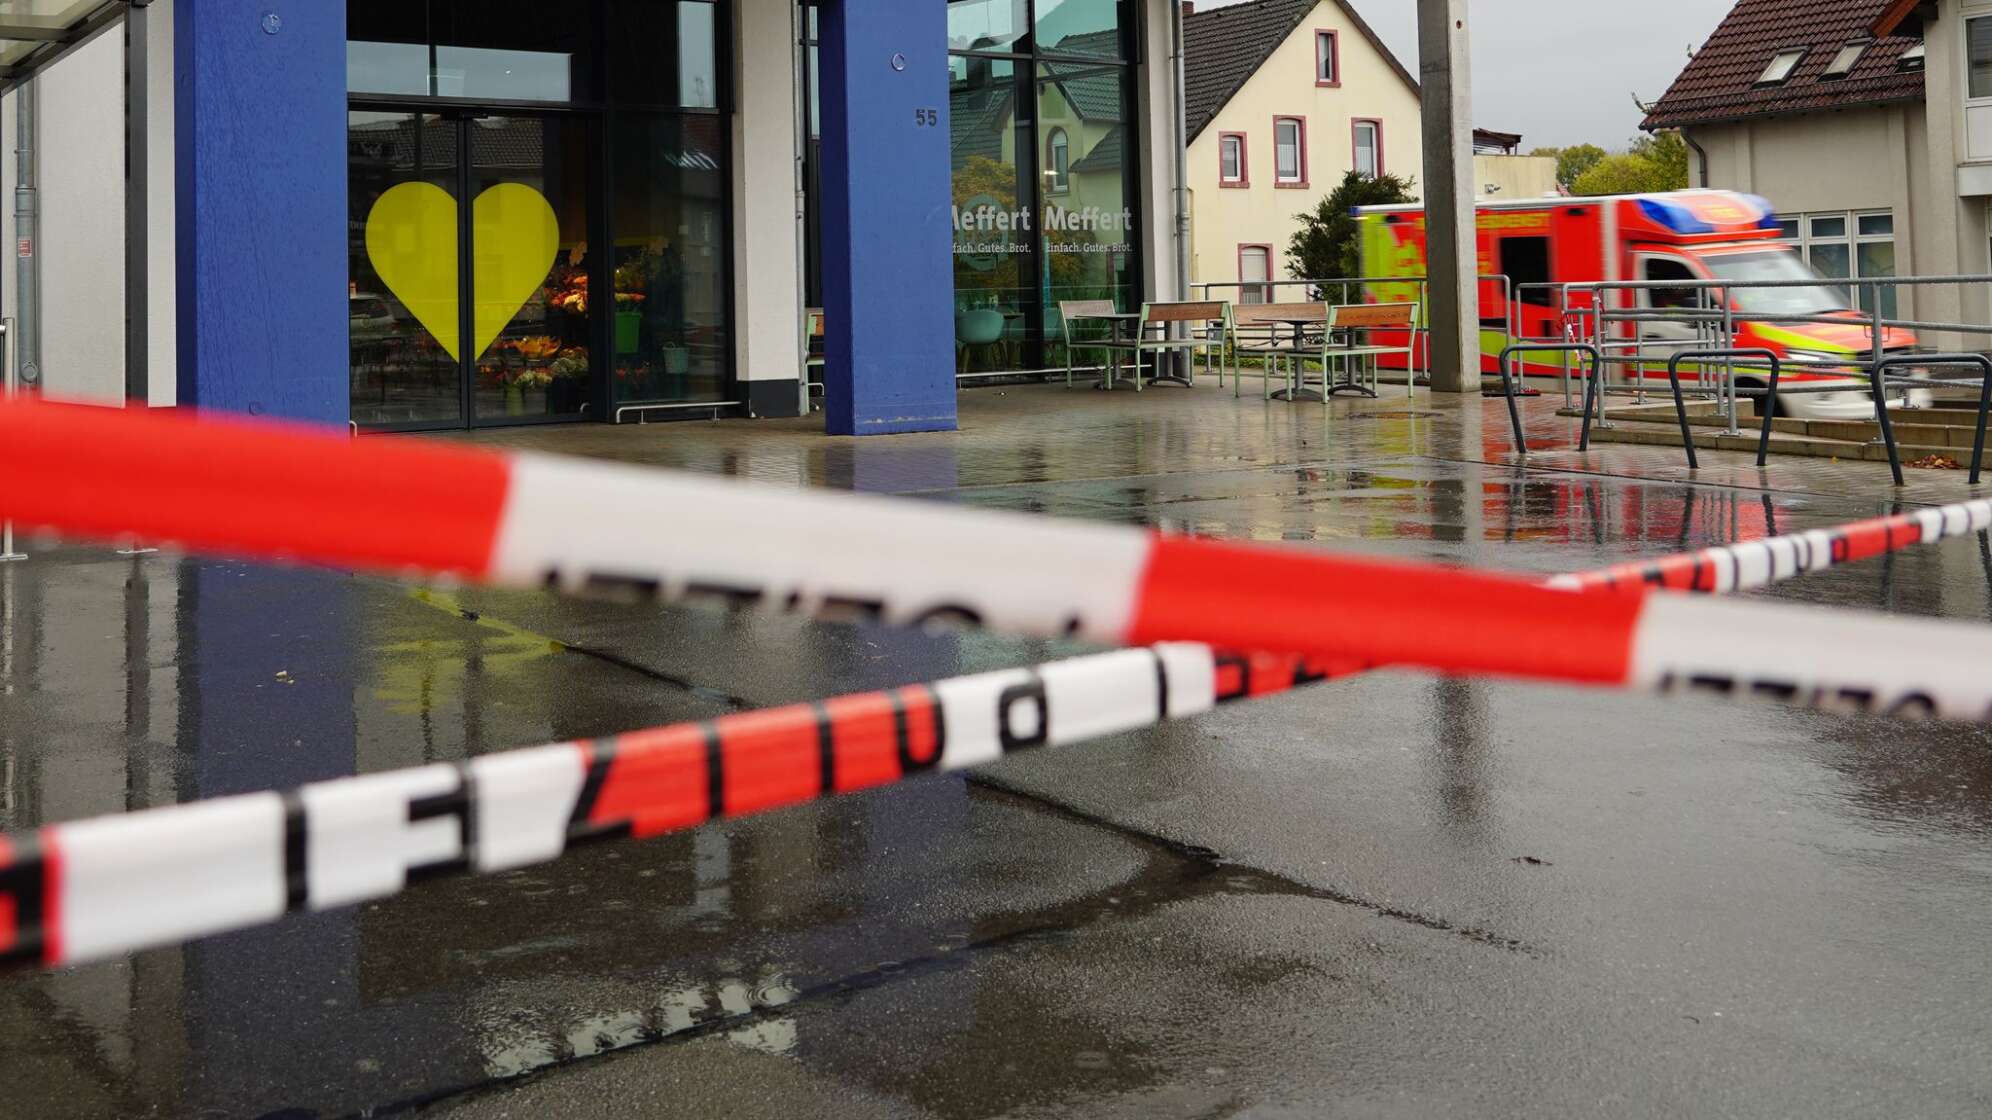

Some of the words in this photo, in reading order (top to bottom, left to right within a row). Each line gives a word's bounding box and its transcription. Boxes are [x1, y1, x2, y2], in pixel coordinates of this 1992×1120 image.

[916, 109, 937, 127] 55
[1044, 206, 1132, 231] Meffert
[952, 242, 976, 254] fach.
[978, 242, 1008, 254] Gutes.
[1008, 242, 1032, 254] Brot.
[1083, 242, 1110, 253] Gutes.
